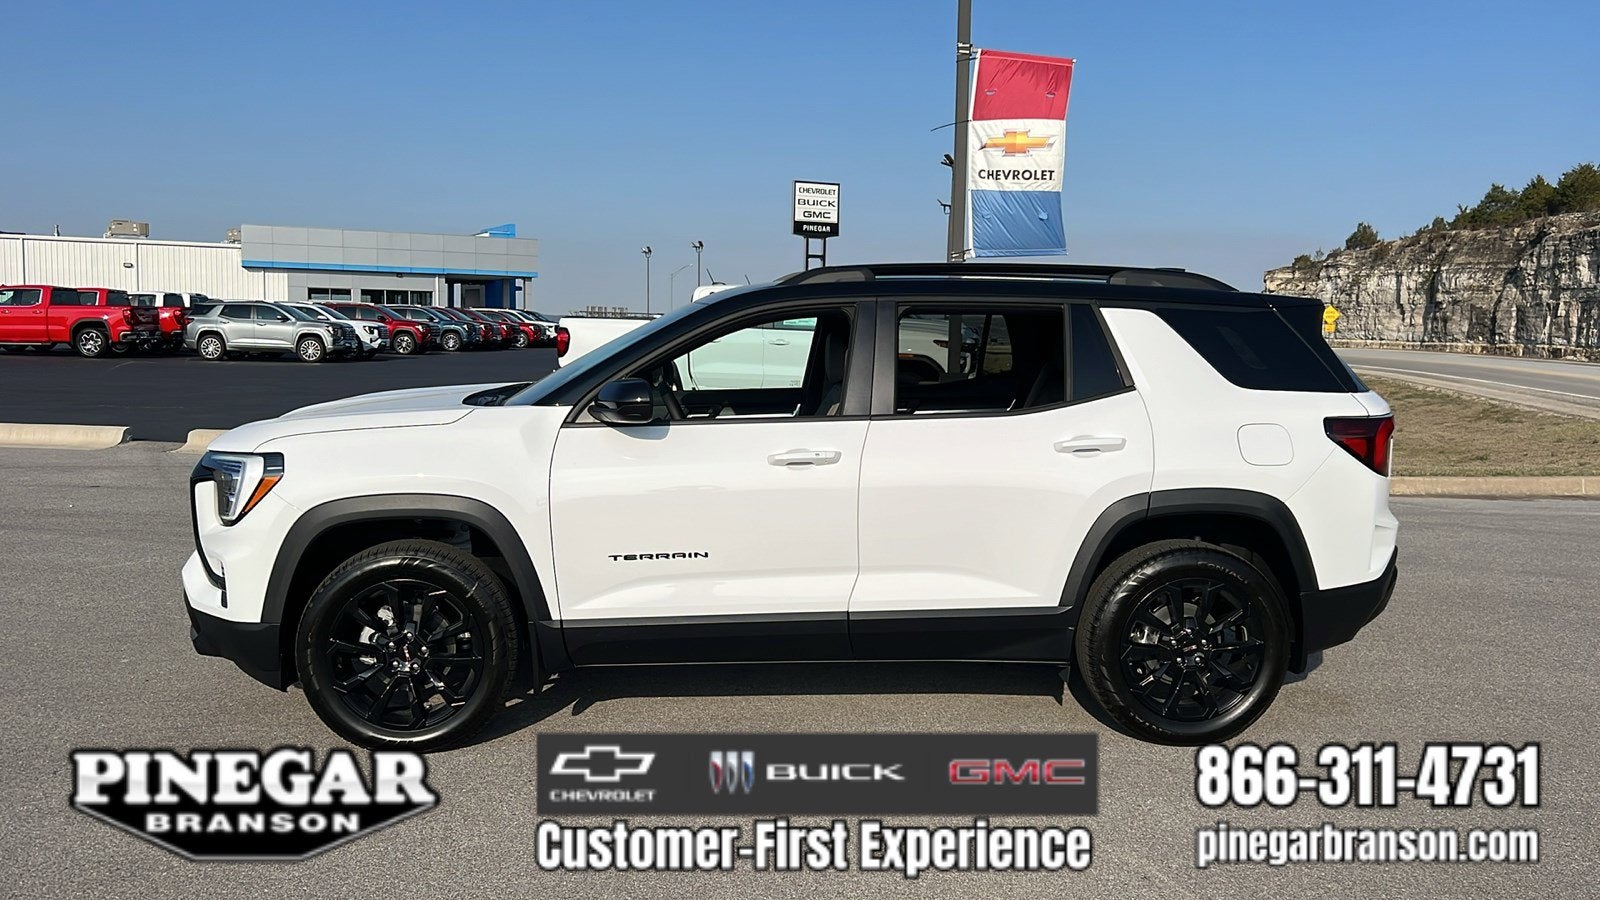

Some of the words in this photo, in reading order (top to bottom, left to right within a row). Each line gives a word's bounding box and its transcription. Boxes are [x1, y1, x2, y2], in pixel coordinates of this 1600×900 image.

[978, 169, 1055, 181] CHEVROLET
[798, 186, 836, 196] CHEVROLET
[797, 198, 836, 208] BUICK
[802, 210, 831, 219] GMC
[802, 224, 831, 233] PINEGAR
[608, 551, 709, 562] TERRAIN
